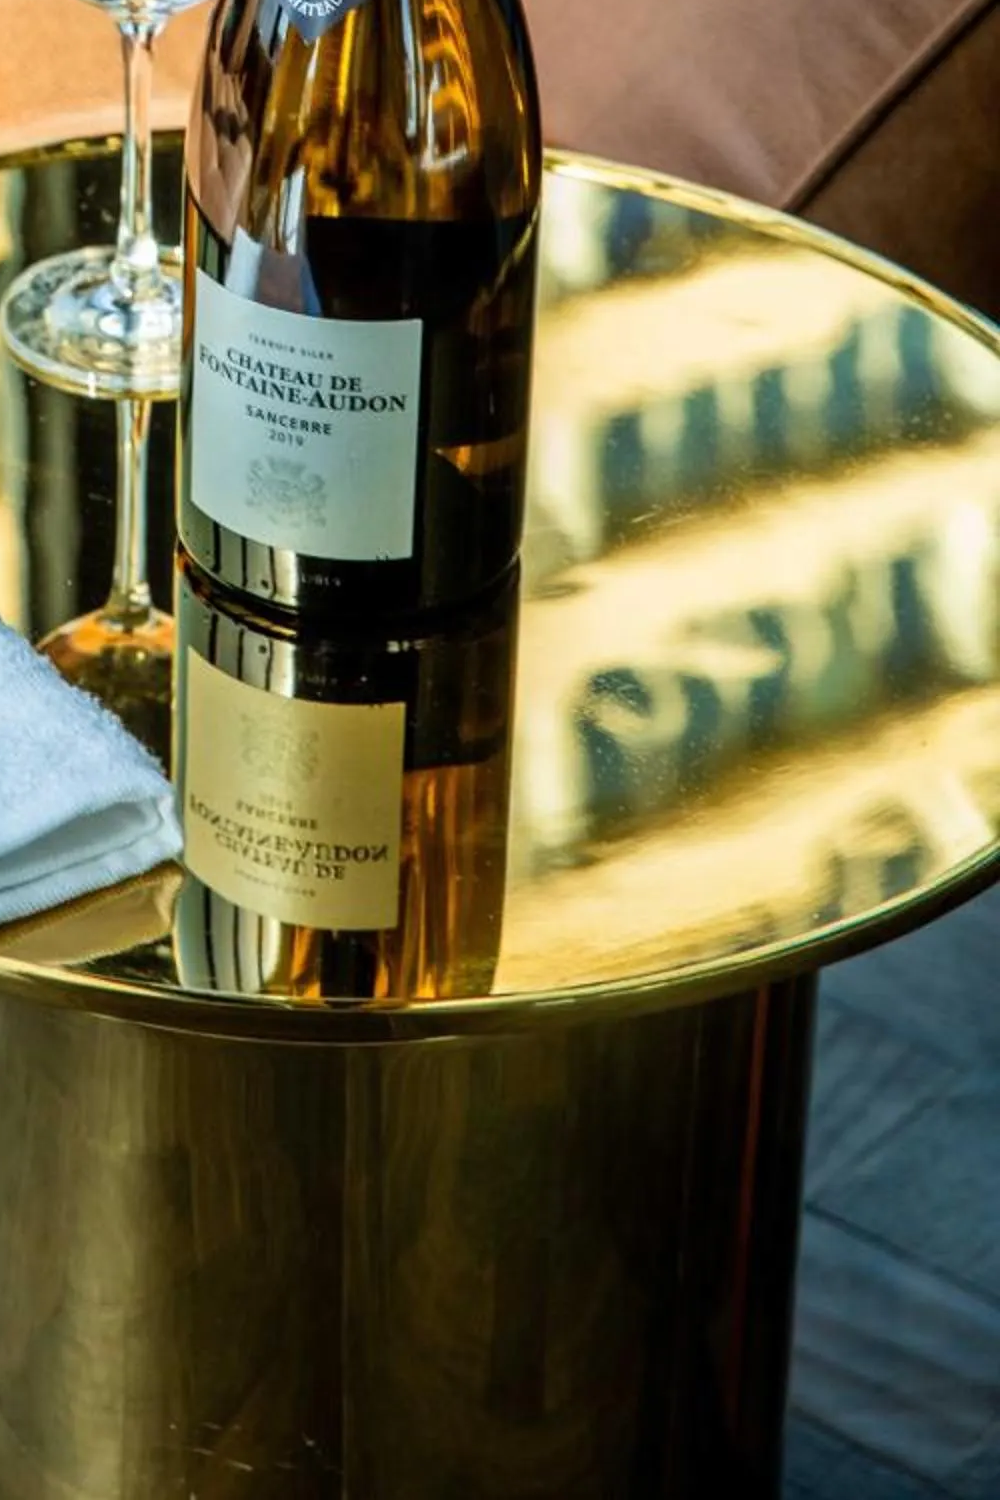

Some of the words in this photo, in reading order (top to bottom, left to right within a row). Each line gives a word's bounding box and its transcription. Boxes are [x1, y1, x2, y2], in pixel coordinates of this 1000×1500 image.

[200, 342, 408, 413] FONTAINE-AUDON
[227, 347, 323, 390] CHATEAU
[330, 375, 362, 393] DE
[246, 404, 332, 435] SANCERRE
[268, 429, 304, 447] 2019
